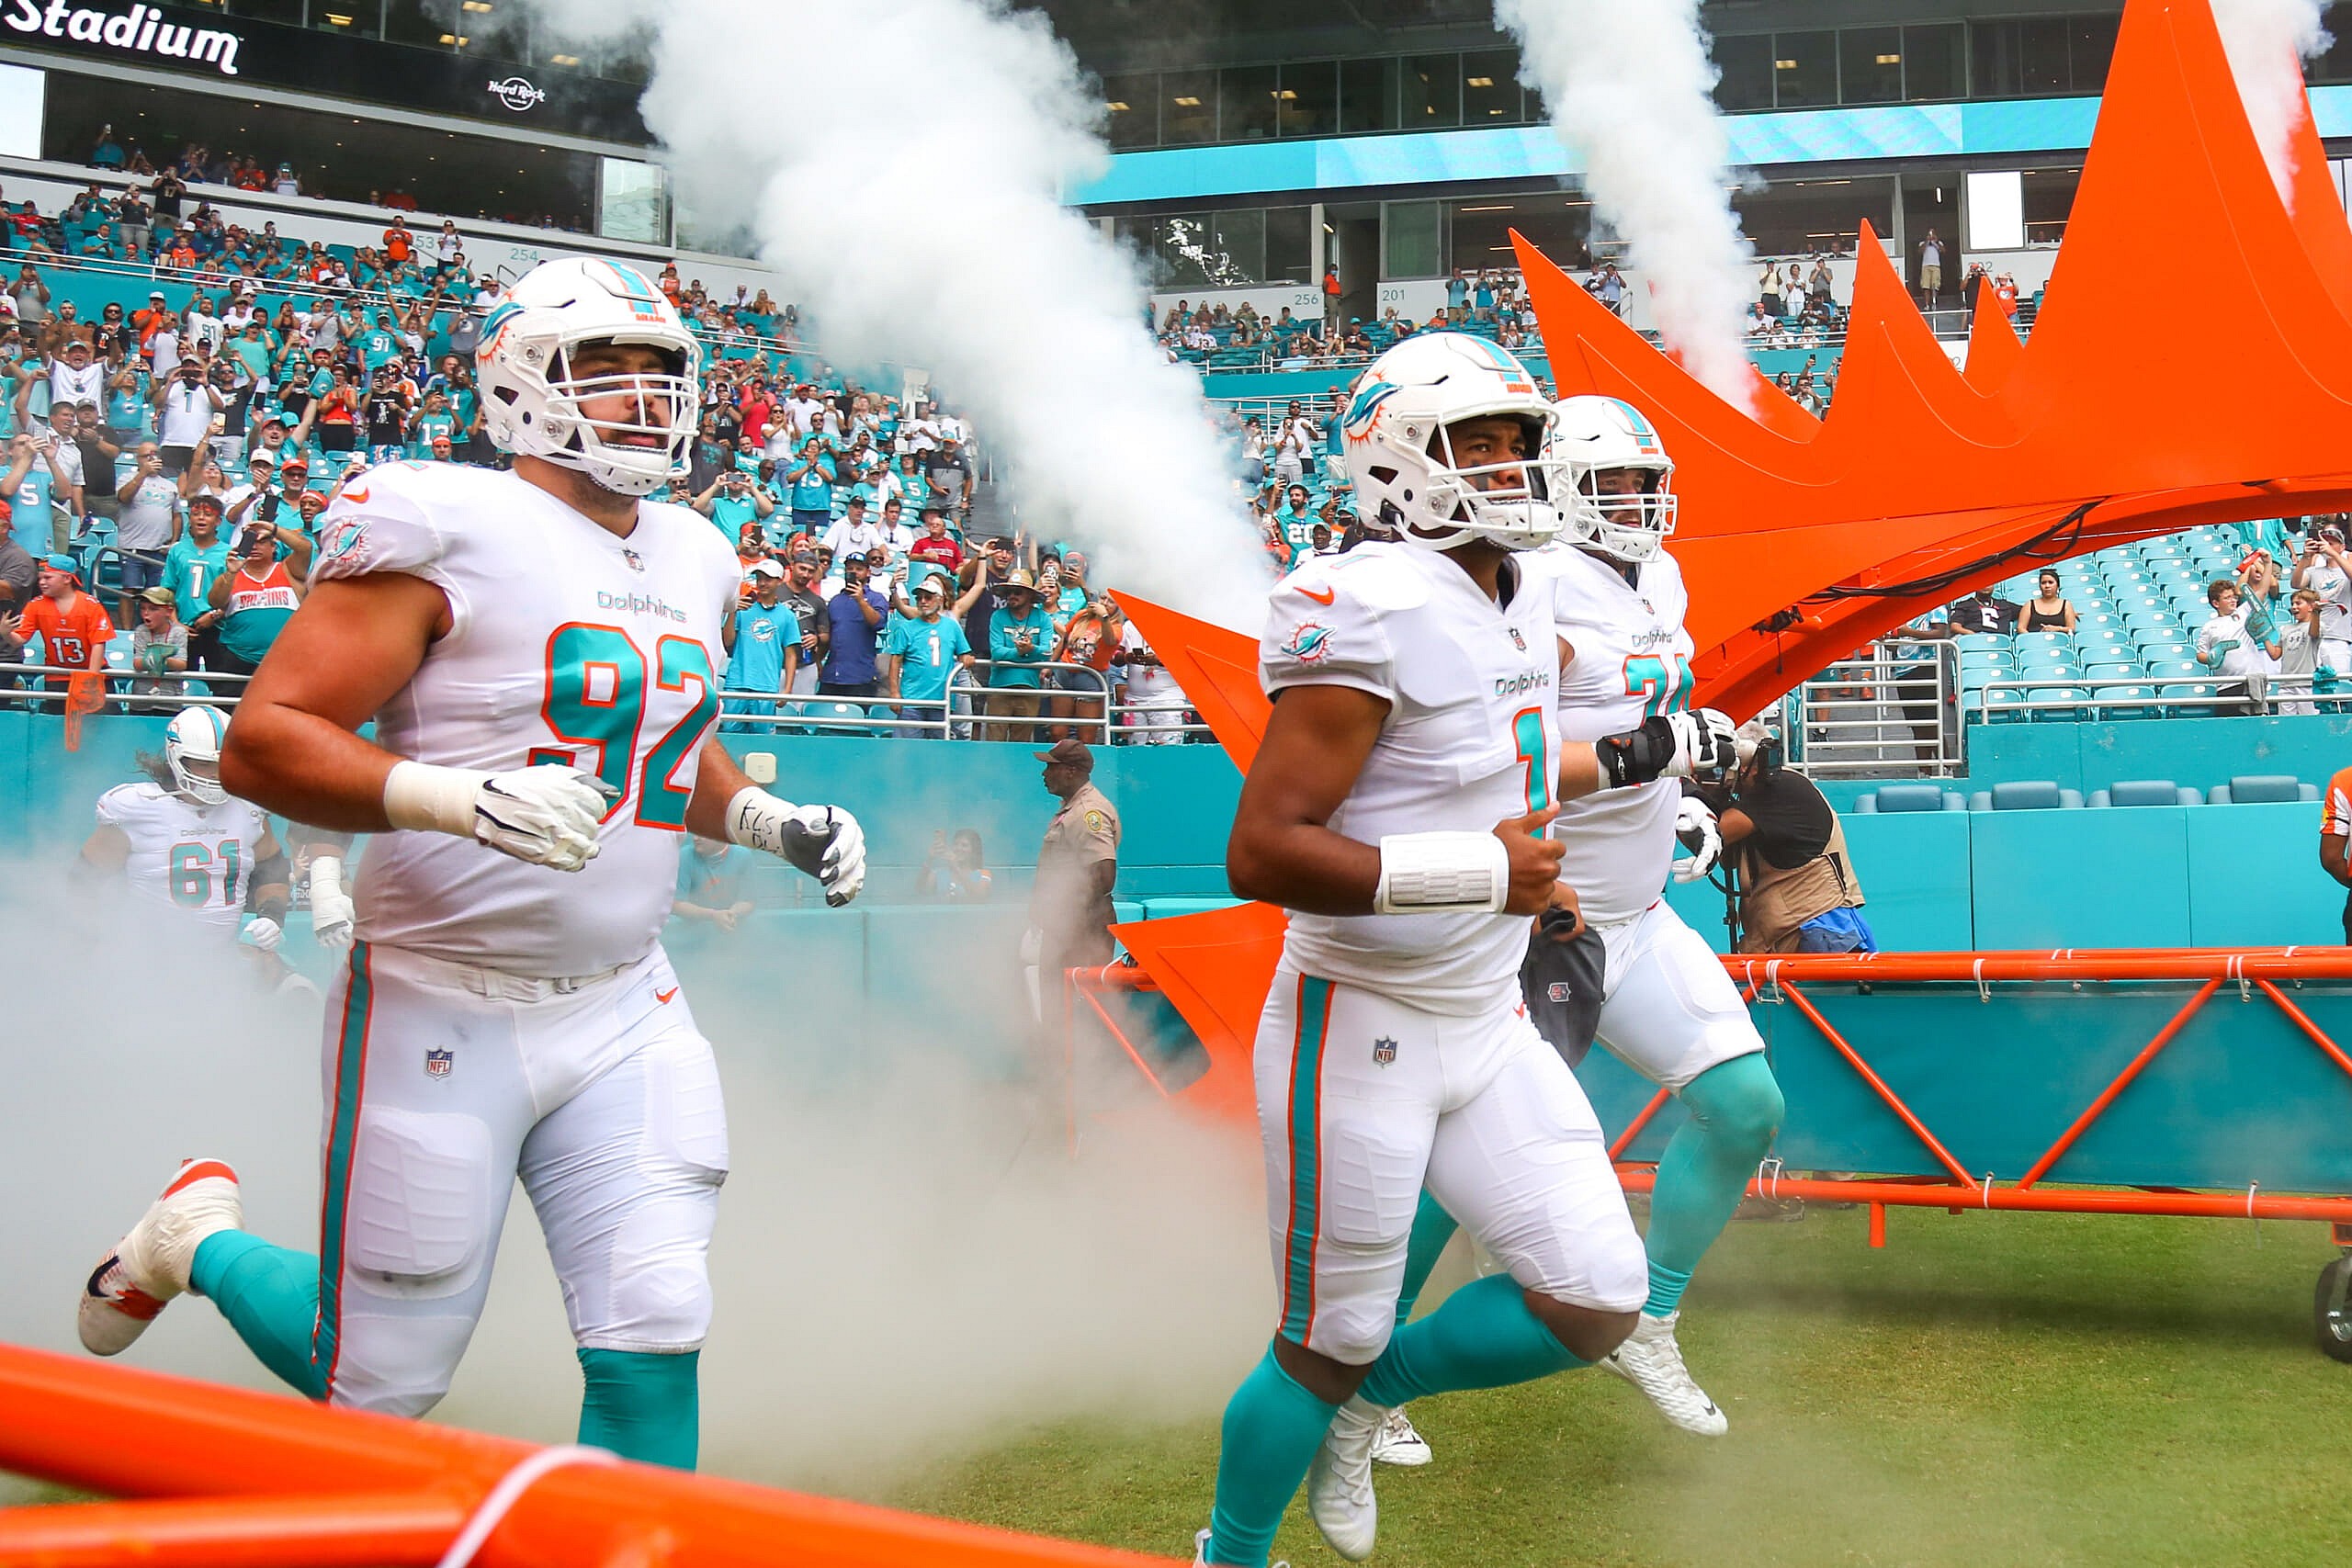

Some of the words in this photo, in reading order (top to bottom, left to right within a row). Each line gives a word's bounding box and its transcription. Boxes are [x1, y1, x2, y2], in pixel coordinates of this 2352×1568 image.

[4, 0, 239, 74] Stadium
[488, 81, 517, 96] Hard
[517, 85, 546, 102] Rock
[416, 236, 435, 249] 53
[511, 248, 538, 261] 254
[1295, 294, 1318, 305] 256
[1383, 289, 1405, 301] 201
[203, 324, 216, 339] 91
[372, 337, 390, 353] 91
[185, 392, 191, 412] 1
[451, 393, 459, 410] 1
[19, 483, 40, 506] 5
[908, 482, 921, 496] 5
[191, 566, 205, 599] 1
[597, 591, 687, 623] Dolphins
[1632, 629, 1672, 648] Dolphins
[52, 637, 85, 663] 13
[928, 637, 941, 667] 1
[1495, 671, 1550, 696] Dolphins
[526, 622, 720, 831] 92
[1512, 705, 1550, 840] 1
[169, 839, 241, 908] 61
[1377, 1050, 1393, 1062] NFL
[428, 1061, 449, 1073] NFL
